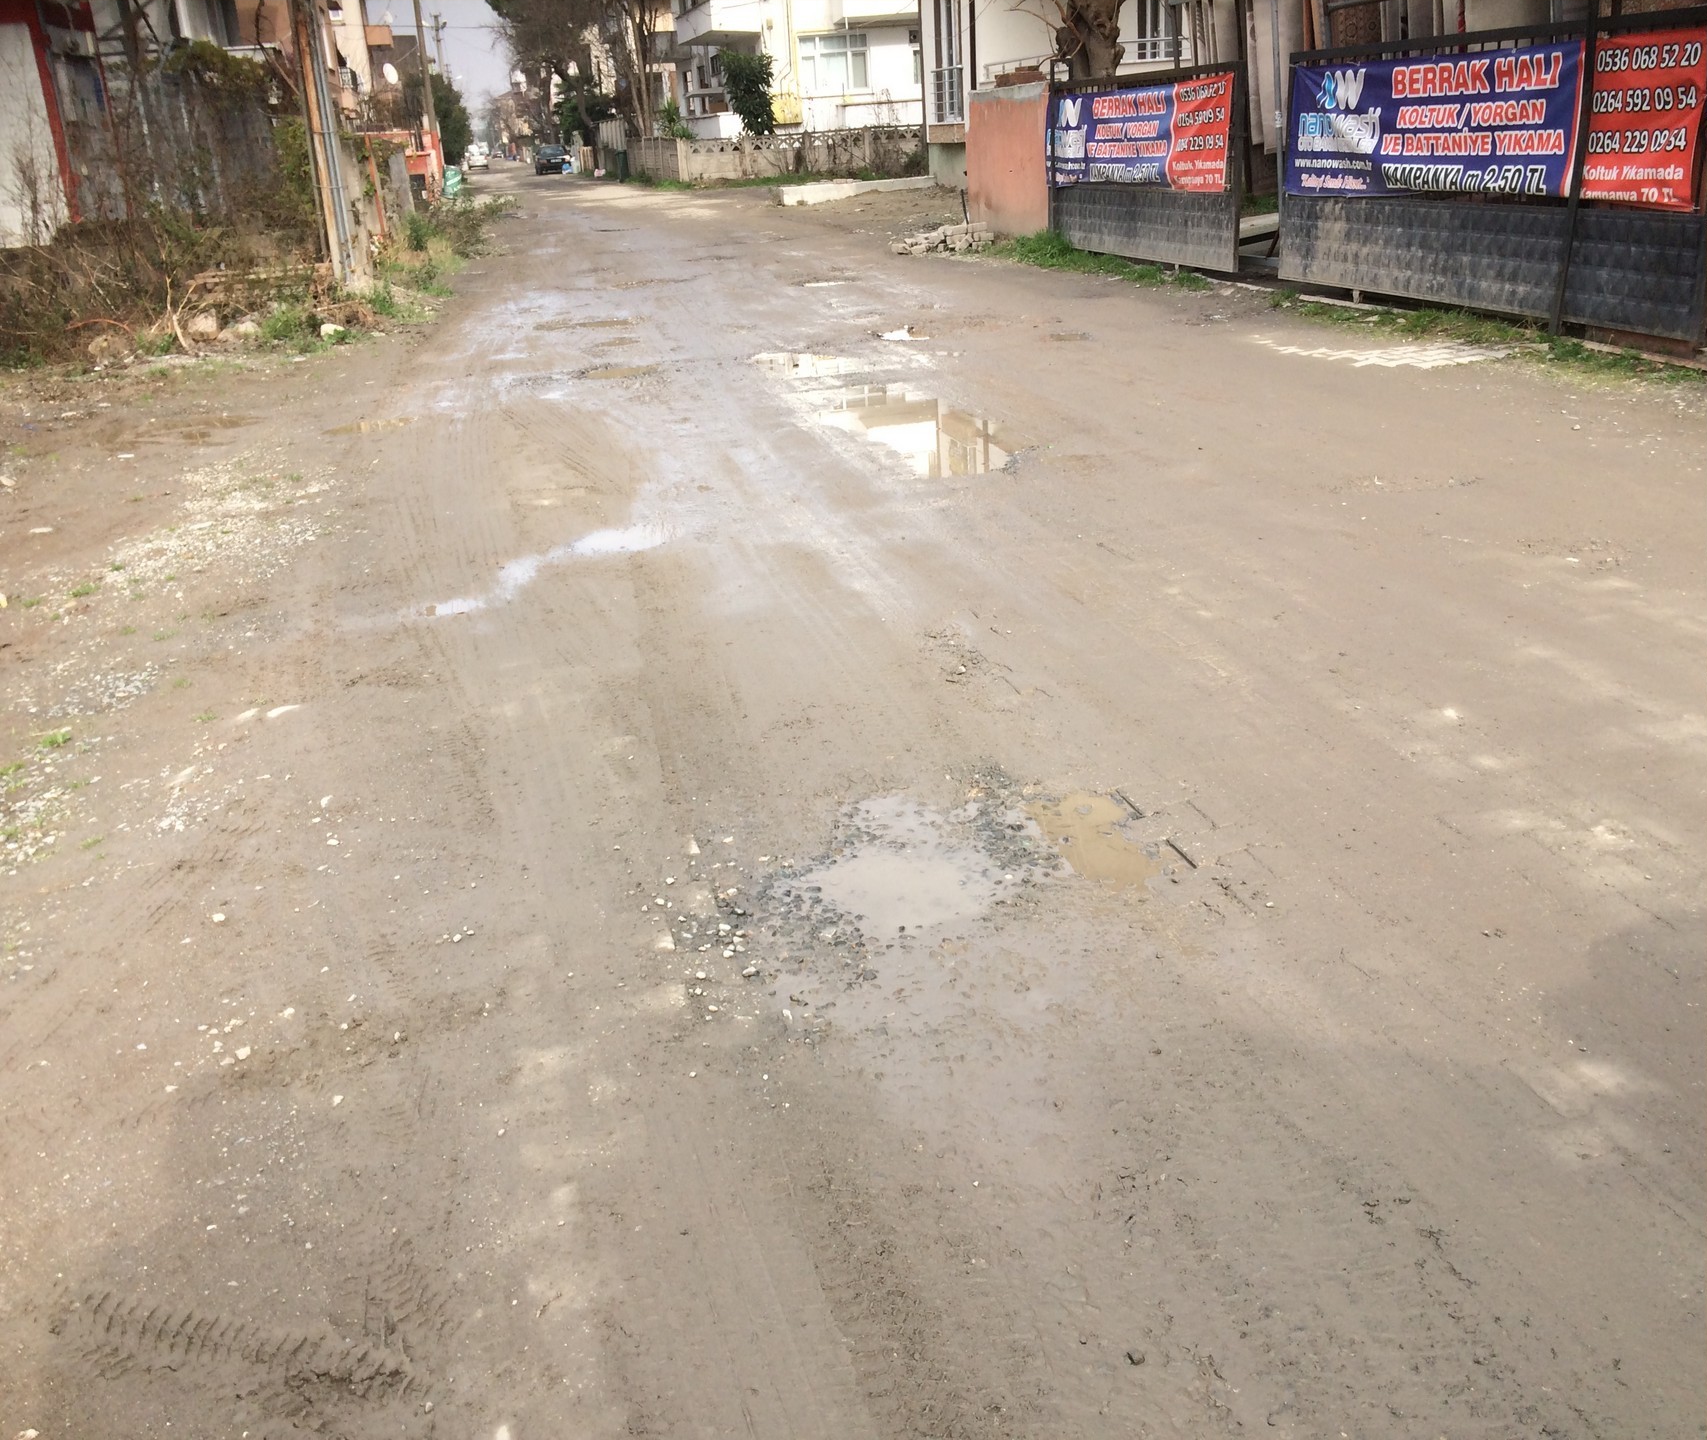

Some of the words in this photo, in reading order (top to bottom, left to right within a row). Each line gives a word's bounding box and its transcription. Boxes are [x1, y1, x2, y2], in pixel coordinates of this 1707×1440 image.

[1597, 49, 1629, 72] 0536
[1632, 45, 1658, 70] 068
[1660, 44, 1680, 69] 52
[1680, 42, 1702, 67] 20
[1392, 59, 1490, 99] BERRAK
[1494, 52, 1562, 93] HALI
[1092, 96, 1137, 120] BERRAK
[1138, 90, 1167, 115] HALI
[1593, 90, 1622, 112] 0264
[1625, 89, 1650, 112] 592
[1654, 87, 1674, 110] 09
[1677, 86, 1697, 109] 54
[1215, 107, 1225, 122] 54
[1396, 103, 1461, 129] KOLTUK
[1470, 99, 1546, 127] YORGAN
[1127, 121, 1159, 138] YORGAN
[1095, 139, 1137, 157] BATTANİYE
[1137, 140, 1167, 156] YIKAMA
[1189, 136, 1204, 151] 229
[1215, 134, 1224, 149] 54
[1380, 134, 1403, 156] VE
[1402, 127, 1493, 156] BATTANİYE
[1494, 129, 1564, 155] YIKAMA
[1588, 131, 1620, 153] 0264
[1622, 130, 1649, 153] 229
[1204, 174, 1214, 184] 70
[1382, 164, 1464, 192] KAMPANYA
[1525, 165, 1547, 196] TL
[1583, 165, 1619, 180] Koltuk
[1621, 164, 1684, 180] Yıkamada
[1641, 187, 1659, 202] 70
